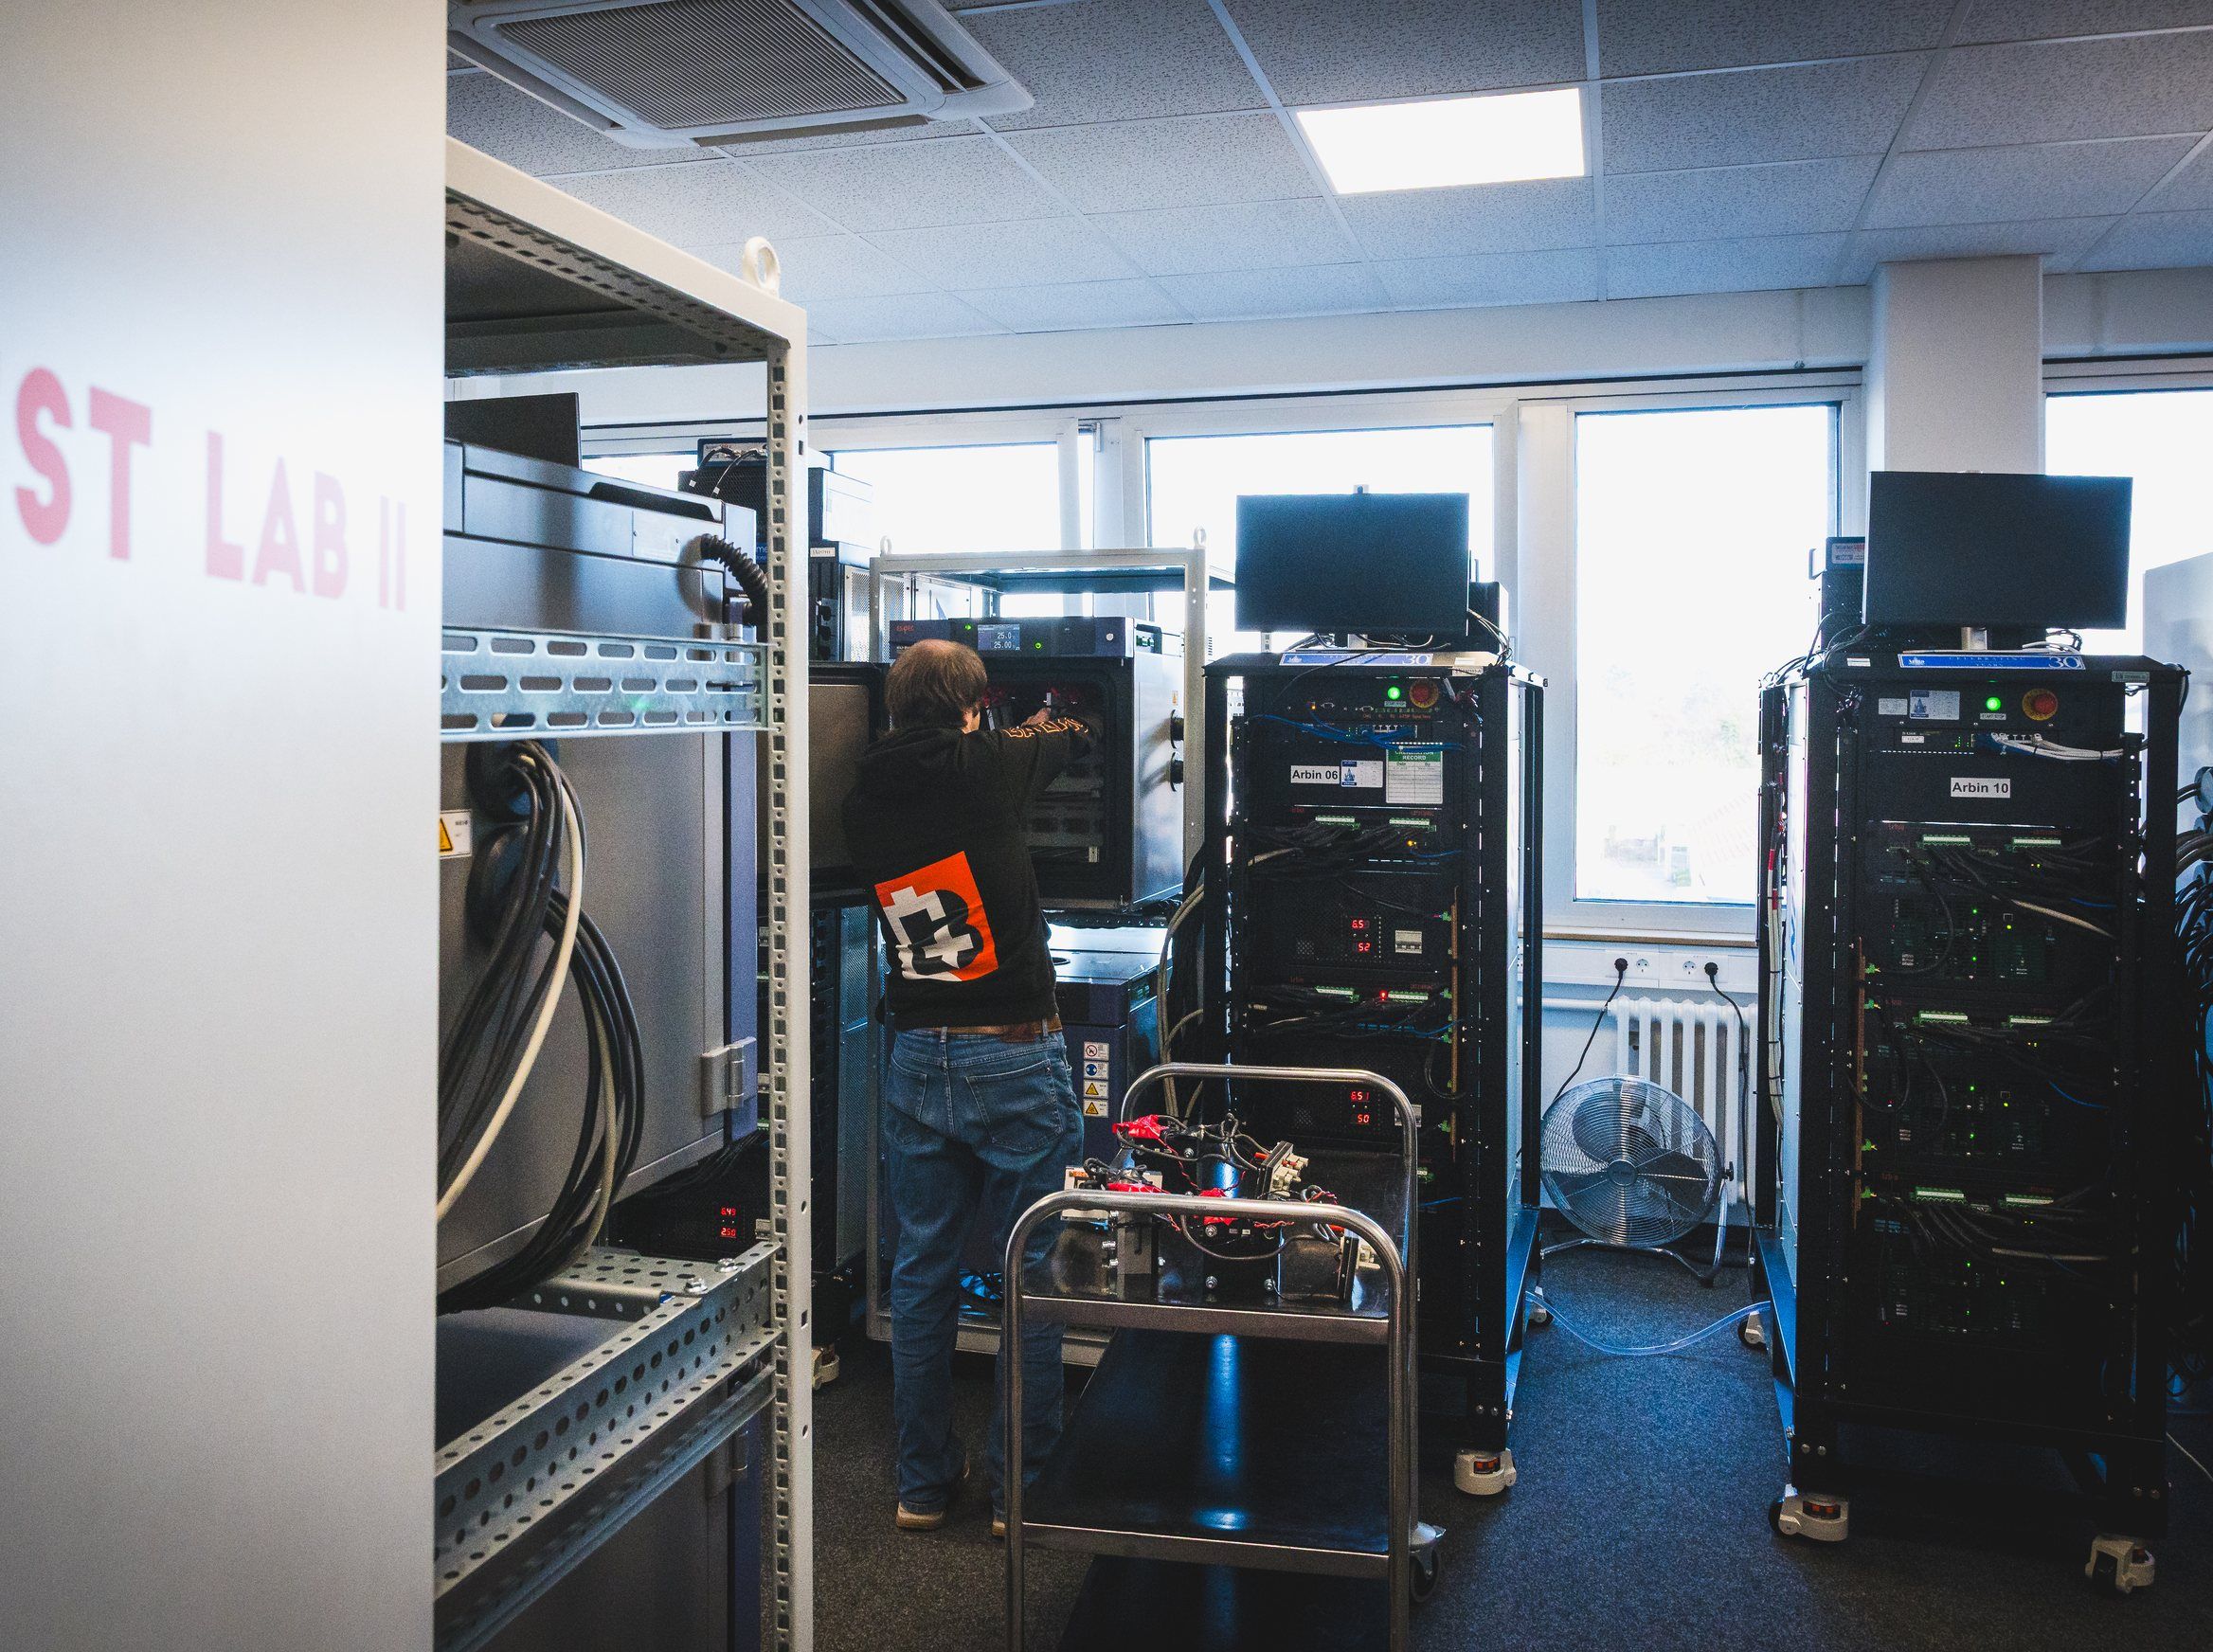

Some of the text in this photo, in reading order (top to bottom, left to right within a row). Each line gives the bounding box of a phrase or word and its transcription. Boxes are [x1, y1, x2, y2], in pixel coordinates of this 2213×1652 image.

[14, 366, 152, 562] ST
[205, 429, 349, 600] LAB
[1403, 654, 1431, 665] 30
[2047, 655, 2080, 669] 30
[1292, 769, 1322, 780] Arbin
[1325, 770, 1338, 780] 06
[1952, 782, 2008, 794] Arbin 10
